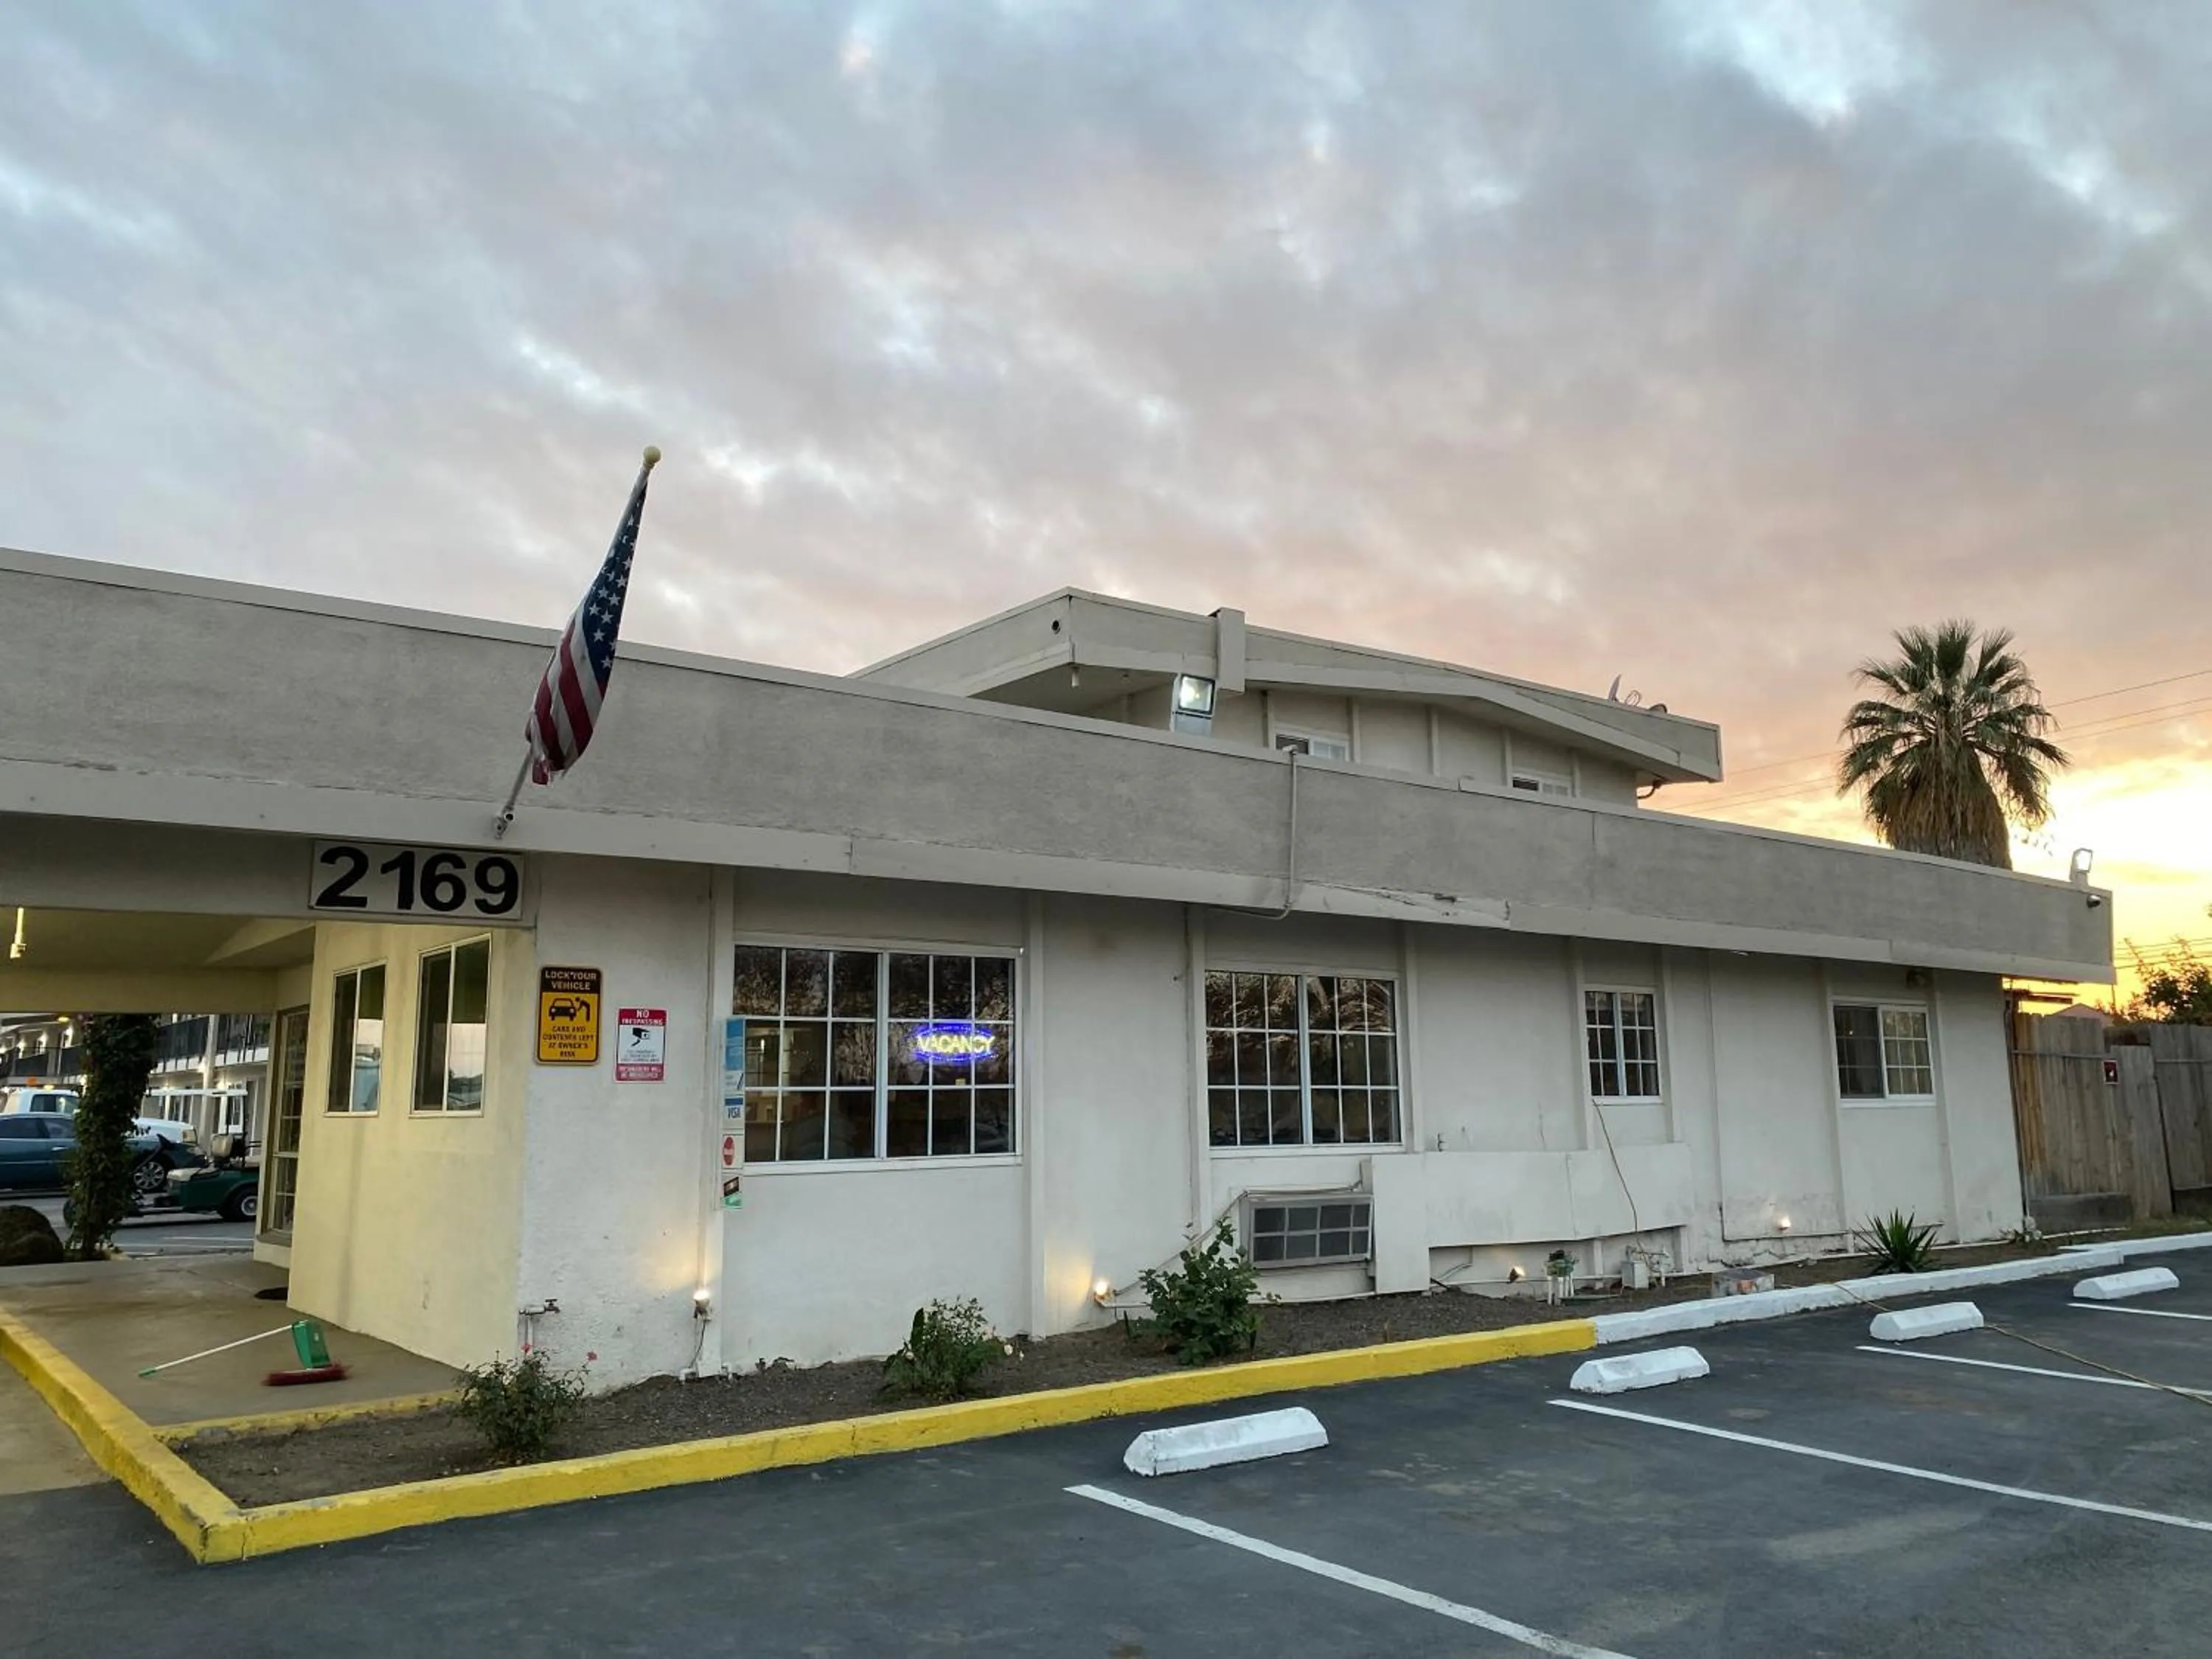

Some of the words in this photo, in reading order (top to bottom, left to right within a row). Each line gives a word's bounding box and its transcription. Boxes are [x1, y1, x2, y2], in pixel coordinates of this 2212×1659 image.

[315, 846, 519, 914] 2169
[545, 970, 570, 980] LOCK
[571, 971, 597, 981] YOUR
[551, 981, 591, 990] VEHICLE
[636, 1009, 650, 1018] NO
[917, 1034, 996, 1054] VACANCY
